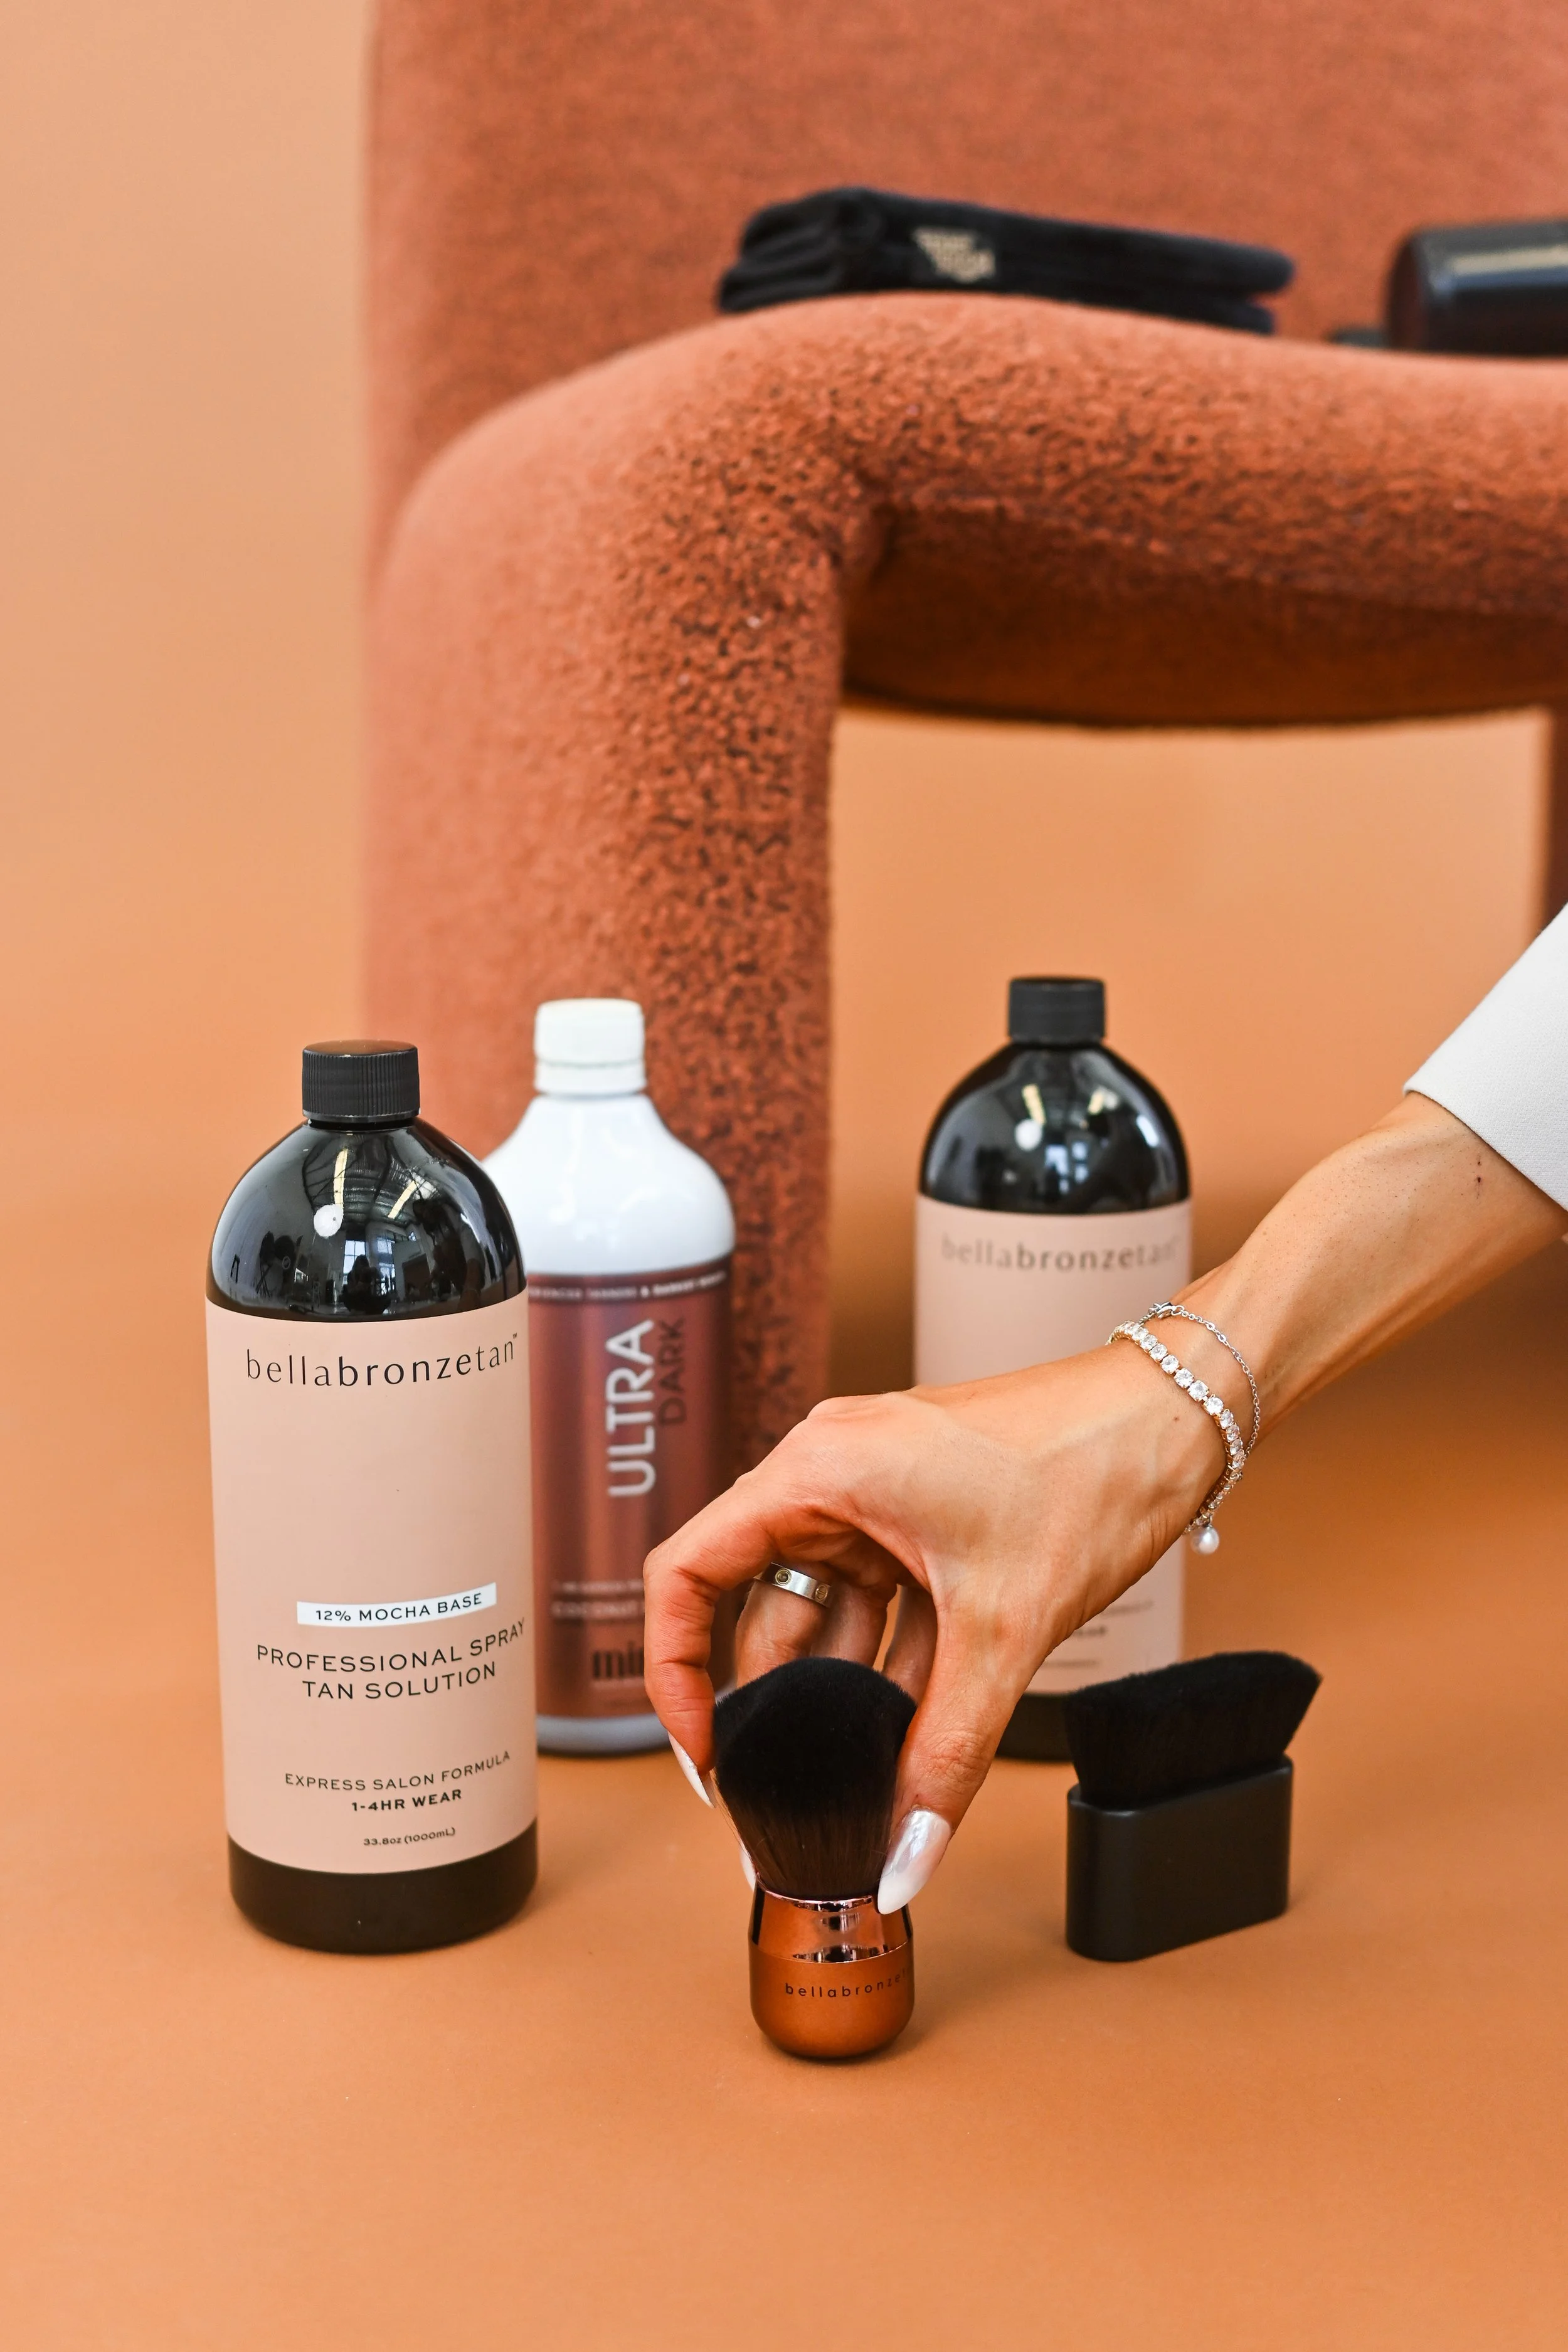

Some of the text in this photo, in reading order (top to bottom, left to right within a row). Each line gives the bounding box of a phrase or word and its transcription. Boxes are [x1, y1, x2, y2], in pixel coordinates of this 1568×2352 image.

[659, 1318, 687, 1426] DARK
[605, 1318, 656, 1498] ULTRA
[315, 1592, 482, 1622] 12% MOCHA BASE
[257, 1617, 526, 1672] PROFESSIONAL SPRAY
[302, 1661, 496, 1699] TAN SOLUTION
[285, 1751, 511, 1791] EXPRESS SALON FORMULA
[351, 1789, 462, 1812] 1-4HR WEAR
[363, 1826, 456, 1846] 33.8oz (1000mL)
